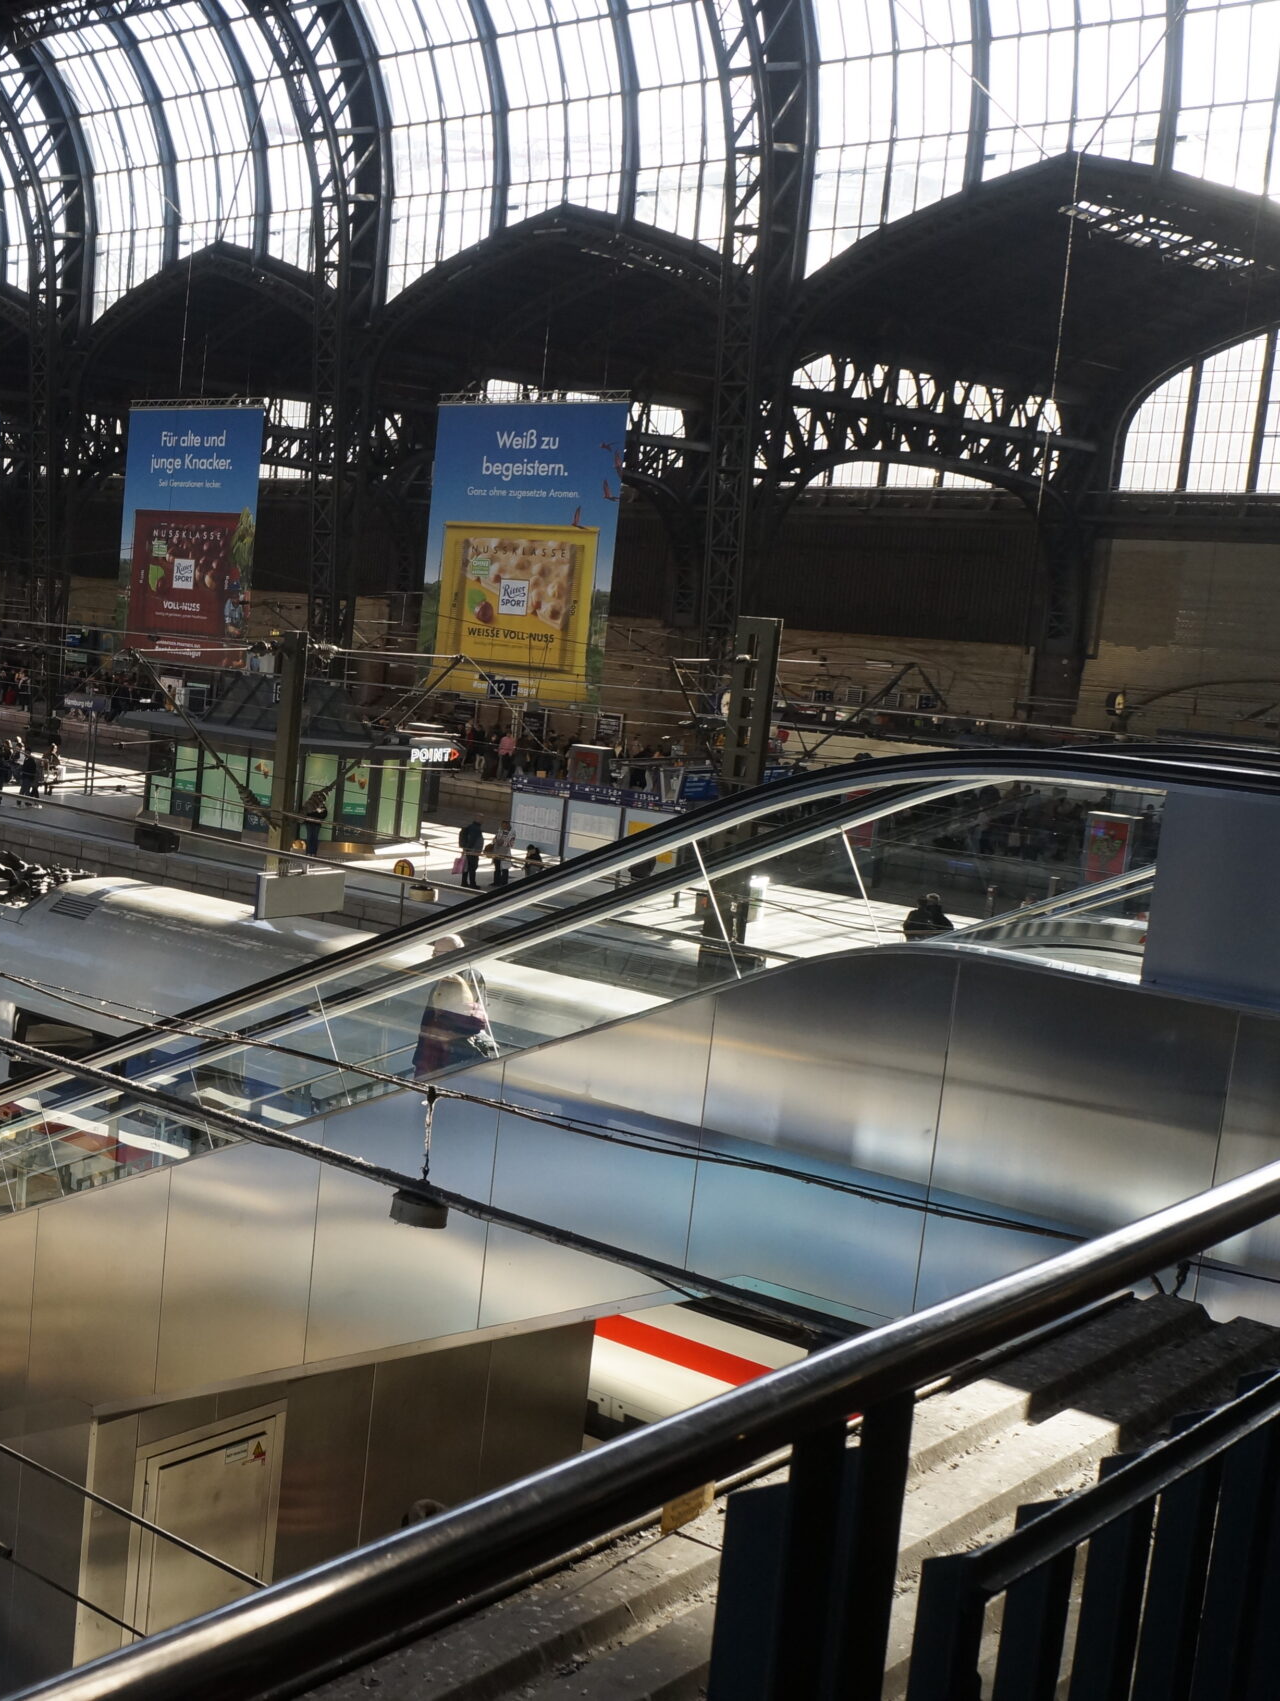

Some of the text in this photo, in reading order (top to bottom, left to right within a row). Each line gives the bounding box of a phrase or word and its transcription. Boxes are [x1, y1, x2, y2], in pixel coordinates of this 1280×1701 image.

[160, 429, 226, 447] Für alte und
[496, 429, 560, 449] Weiß zu
[150, 452, 232, 474] junge Knacker.
[482, 455, 568, 481] begeistern.
[467, 486, 580, 499] Ganz ohne zugesetzte Aromen.
[153, 529, 222, 540] NUSSKLASSE
[471, 545, 567, 558] NUSSKLASSE
[174, 575, 193, 583] SPORT
[503, 584, 526, 598] Ritter
[163, 600, 201, 612] VOLL-NUSS
[501, 598, 526, 608] SPORT
[467, 626, 555, 643] WEISSE VOLL-NUSS
[410, 748, 451, 763] POINT
